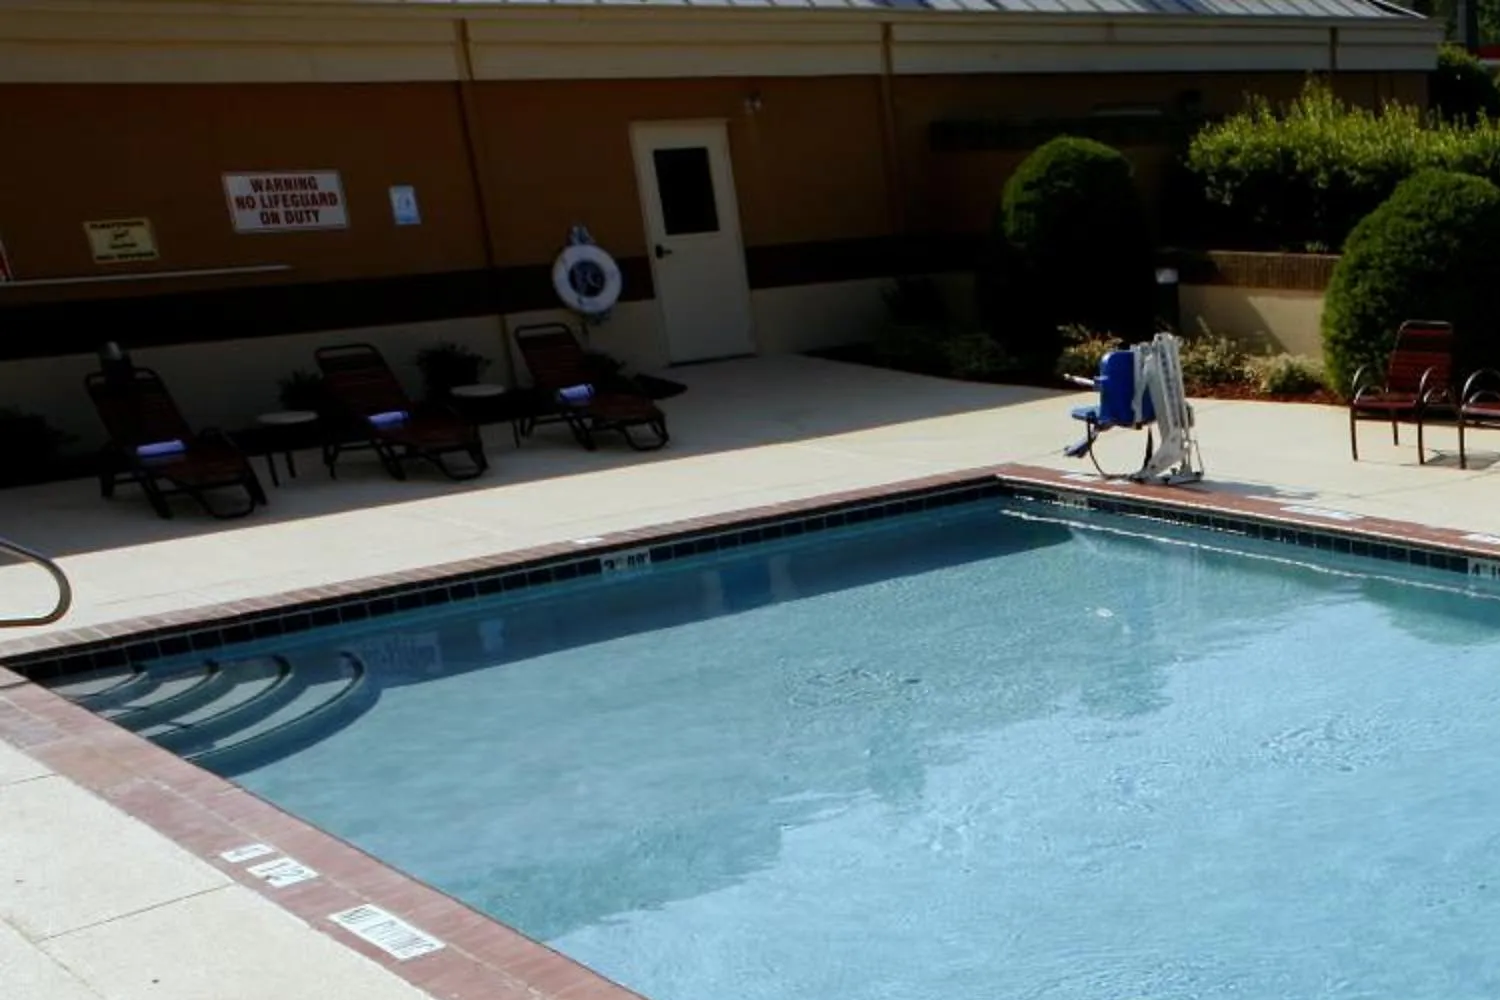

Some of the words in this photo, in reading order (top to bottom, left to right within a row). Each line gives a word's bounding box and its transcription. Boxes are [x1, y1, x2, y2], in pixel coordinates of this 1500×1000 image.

[249, 176, 319, 193] WARNING
[235, 195, 256, 210] NO
[260, 192, 338, 209] LIFEGUARD
[260, 211, 280, 225] ON
[284, 209, 320, 225] DUTY
